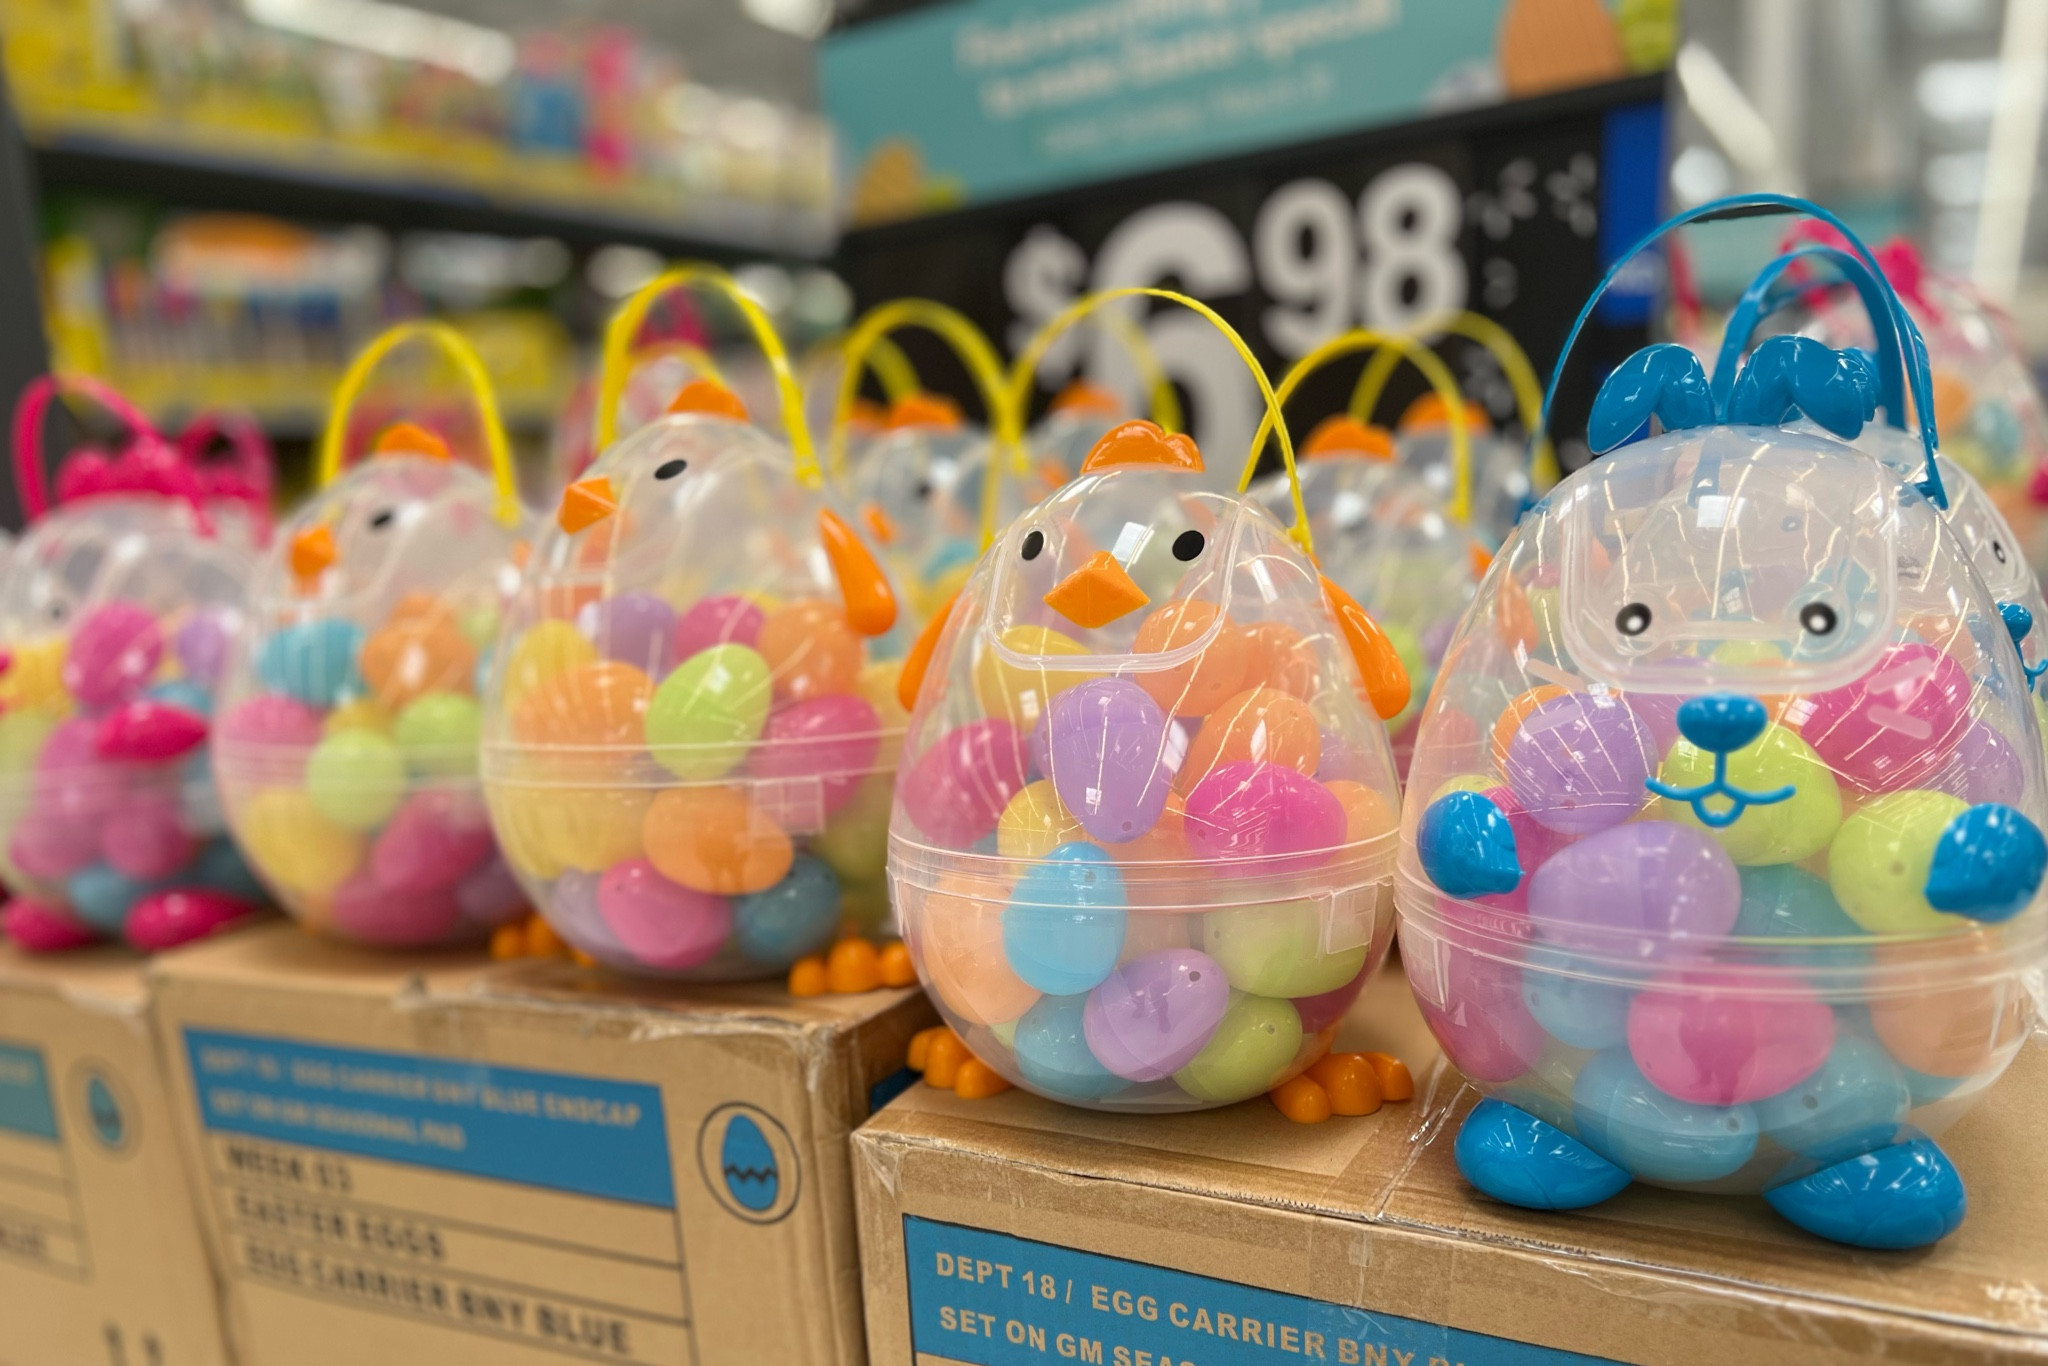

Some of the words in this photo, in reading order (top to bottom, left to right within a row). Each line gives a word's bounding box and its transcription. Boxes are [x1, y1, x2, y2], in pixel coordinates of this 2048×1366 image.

[536, 1303, 629, 1354] BLUE
[935, 1251, 1014, 1289] DEPT
[1091, 1284, 1159, 1322] EGG
[1168, 1302, 1326, 1360] CARRIER
[939, 1305, 996, 1338] SET
[1005, 1319, 1047, 1352] ON
[1055, 1332, 1104, 1366] GM
[1112, 1345, 1196, 1366] SE
